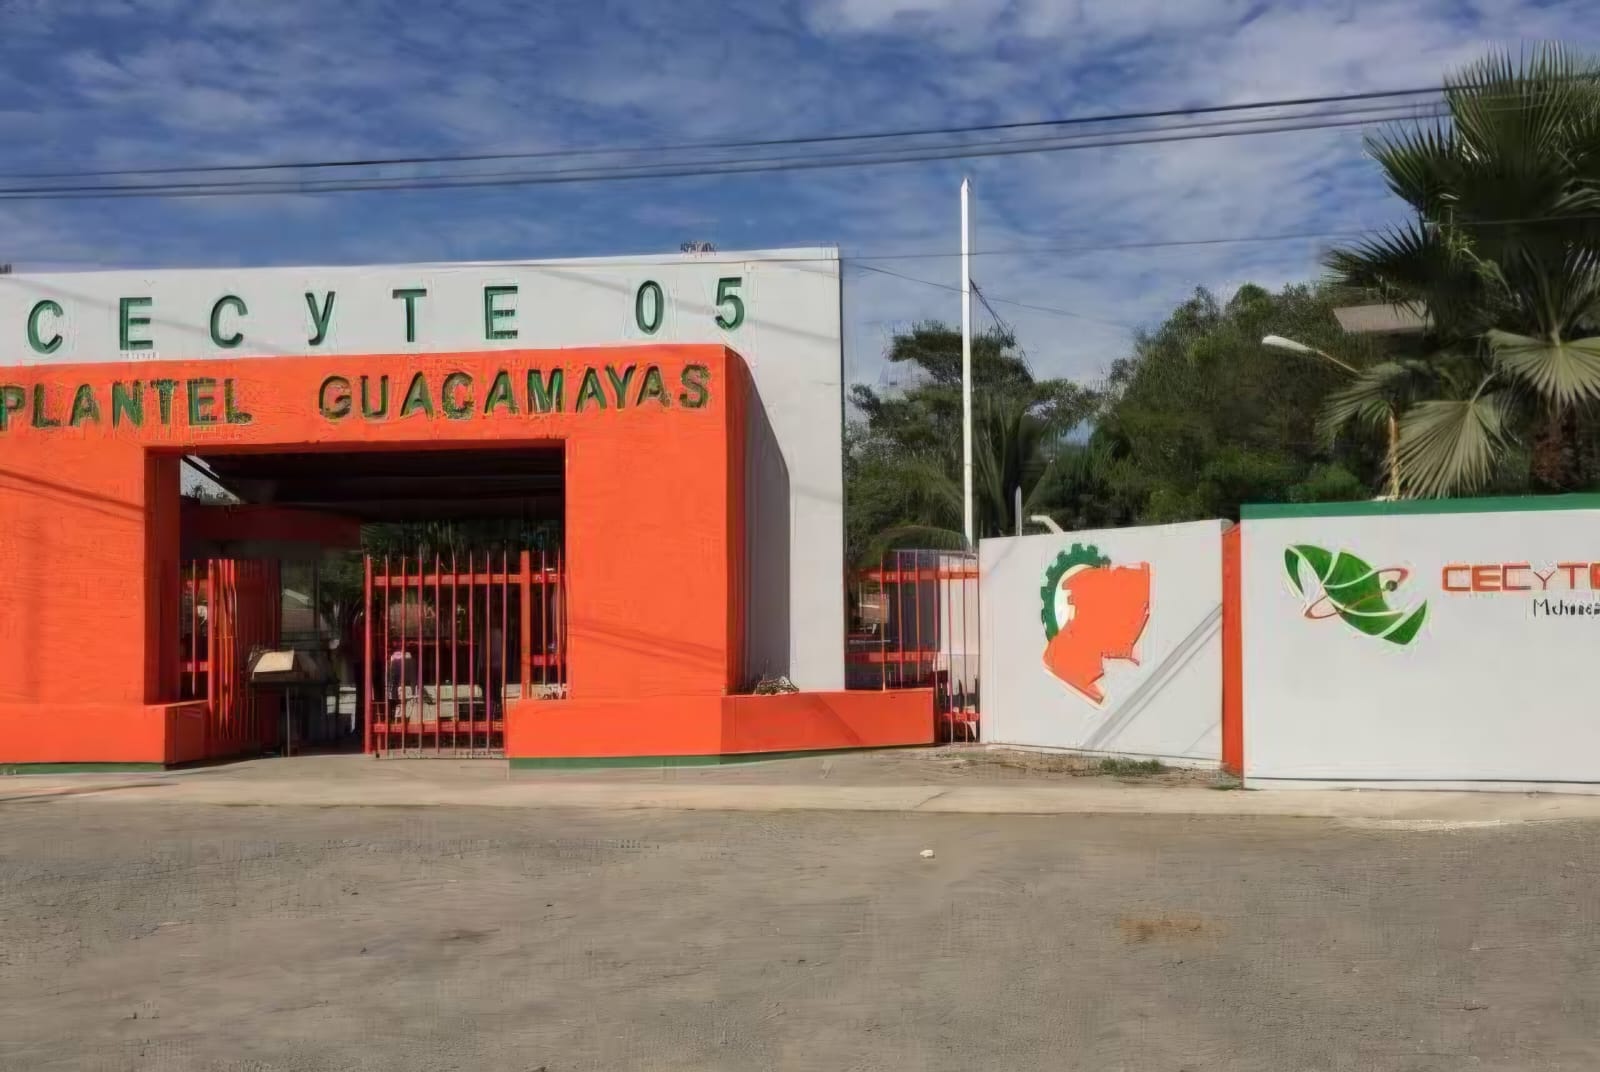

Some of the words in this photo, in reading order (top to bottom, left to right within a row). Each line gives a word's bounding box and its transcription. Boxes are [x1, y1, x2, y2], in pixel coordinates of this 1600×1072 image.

[635, 276, 745, 335] 05
[0, 378, 253, 431] PLANTEL
[318, 363, 711, 422] GUACAMAYAS
